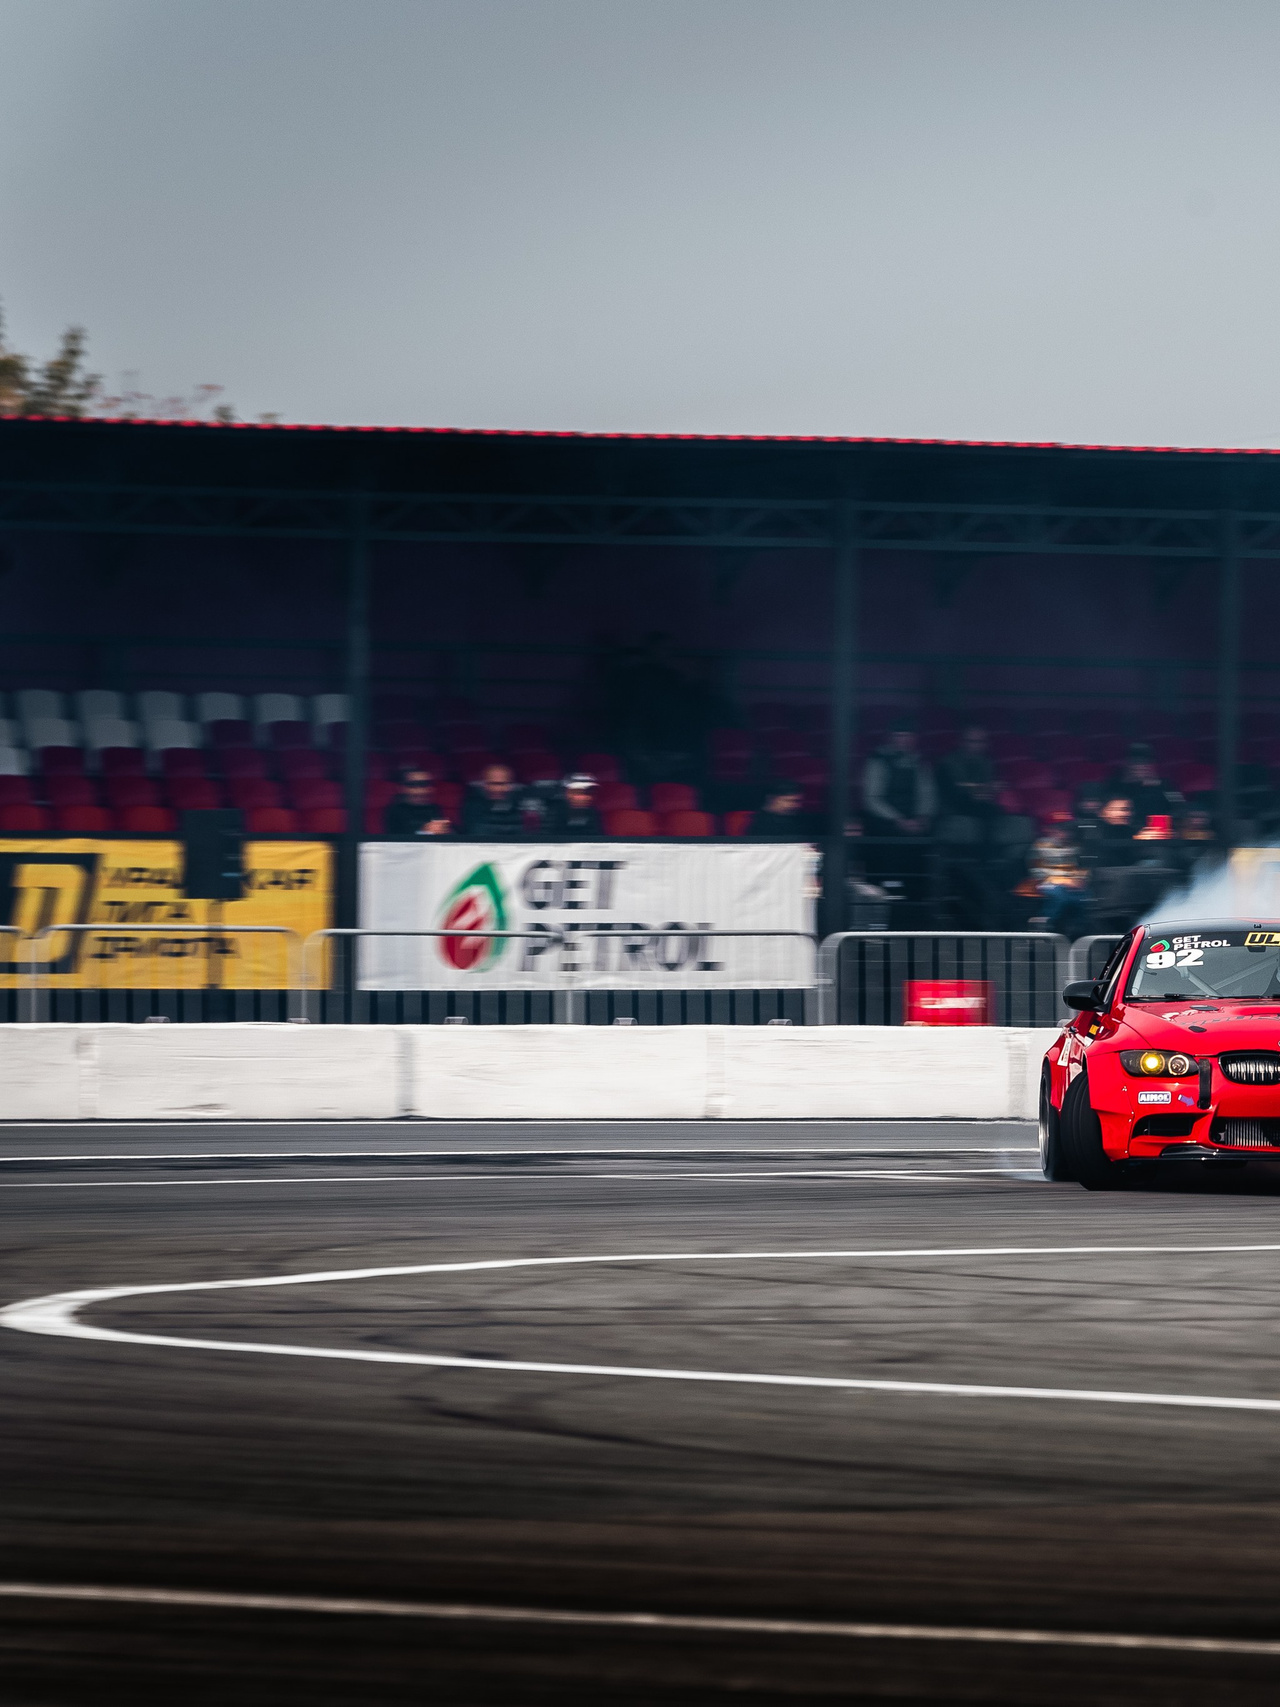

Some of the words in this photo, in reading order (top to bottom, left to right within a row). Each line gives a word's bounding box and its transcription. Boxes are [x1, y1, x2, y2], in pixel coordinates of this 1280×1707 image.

[518, 860, 628, 910] GET
[517, 921, 726, 972] PETROL
[1172, 935, 1201, 944] GET
[1173, 940, 1231, 951] PETROL
[1146, 949, 1204, 969] 92
